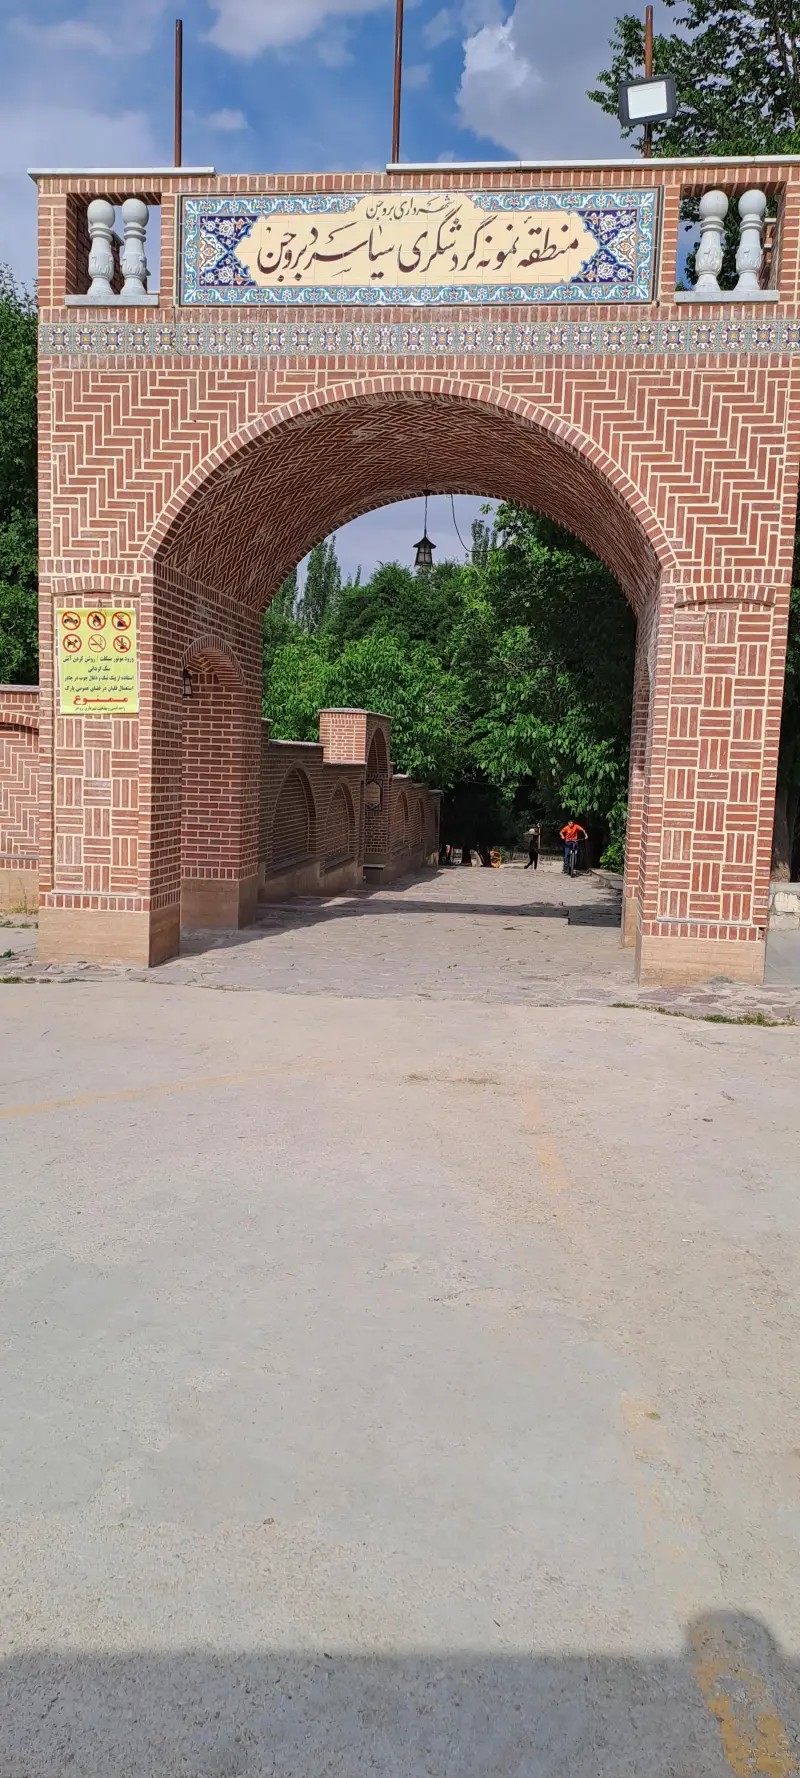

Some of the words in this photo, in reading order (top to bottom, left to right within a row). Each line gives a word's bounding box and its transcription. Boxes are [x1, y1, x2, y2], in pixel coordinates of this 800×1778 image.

[366, 200, 395, 221] بروجن
[394, 194, 455, 220] شهرداری
[398, 204, 499, 273] گردشگری
[476, 223, 520, 271] نمونه
[257, 226, 308, 282] بروجن
[62, 655, 72, 663] آتش
[72, 695, 129, 706] ممنوع
